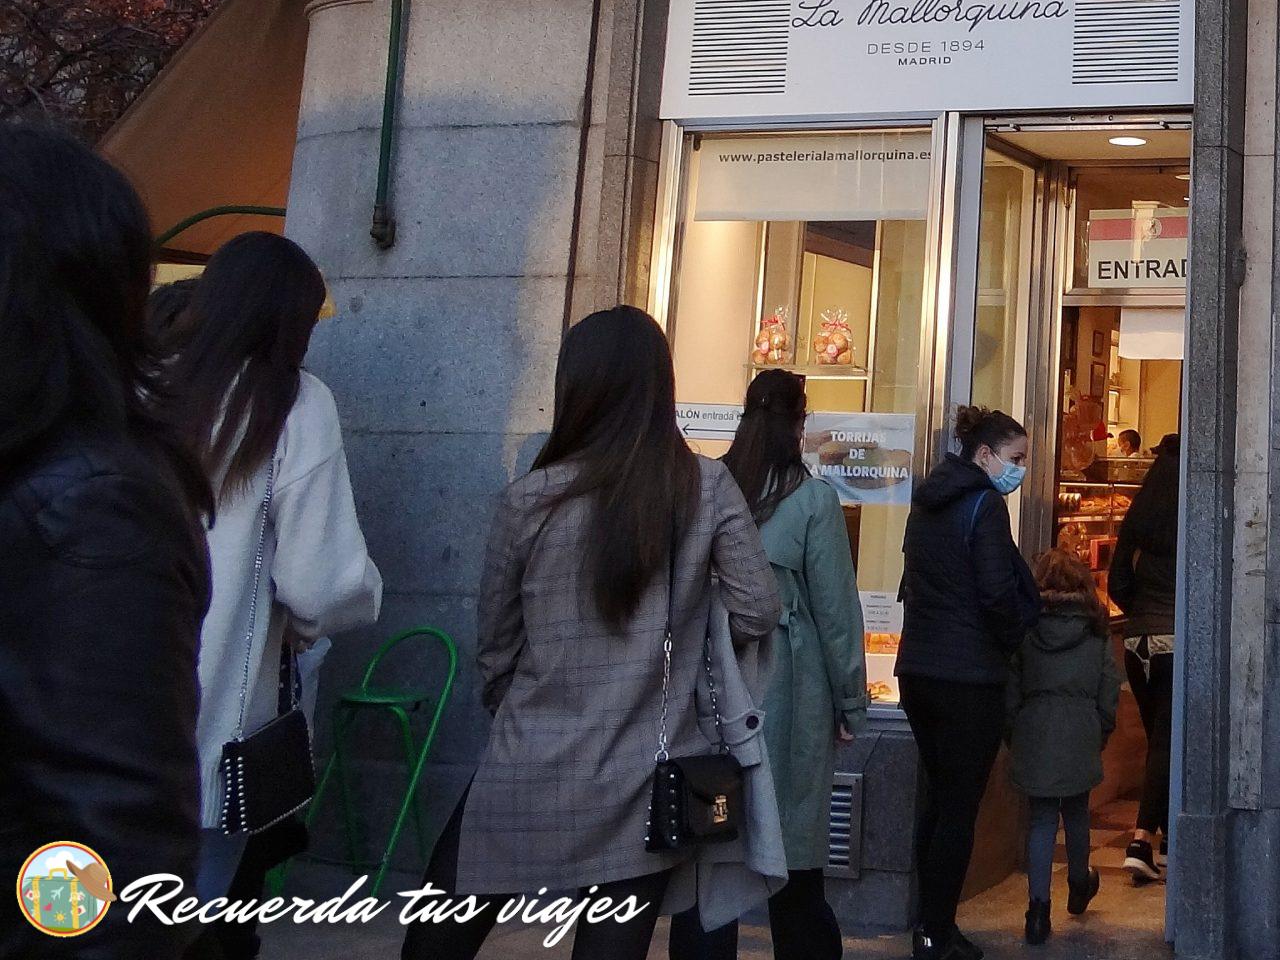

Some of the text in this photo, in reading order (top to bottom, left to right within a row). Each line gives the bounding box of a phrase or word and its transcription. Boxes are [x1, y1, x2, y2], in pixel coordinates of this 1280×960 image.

[867, 39, 986, 55] DESDE 1894
[897, 56, 952, 66] MADRID
[676, 408, 700, 419] ALÓN
[702, 410, 734, 420] entrada
[849, 448, 867, 460] DE
[820, 464, 909, 478] MALLORQUINA
